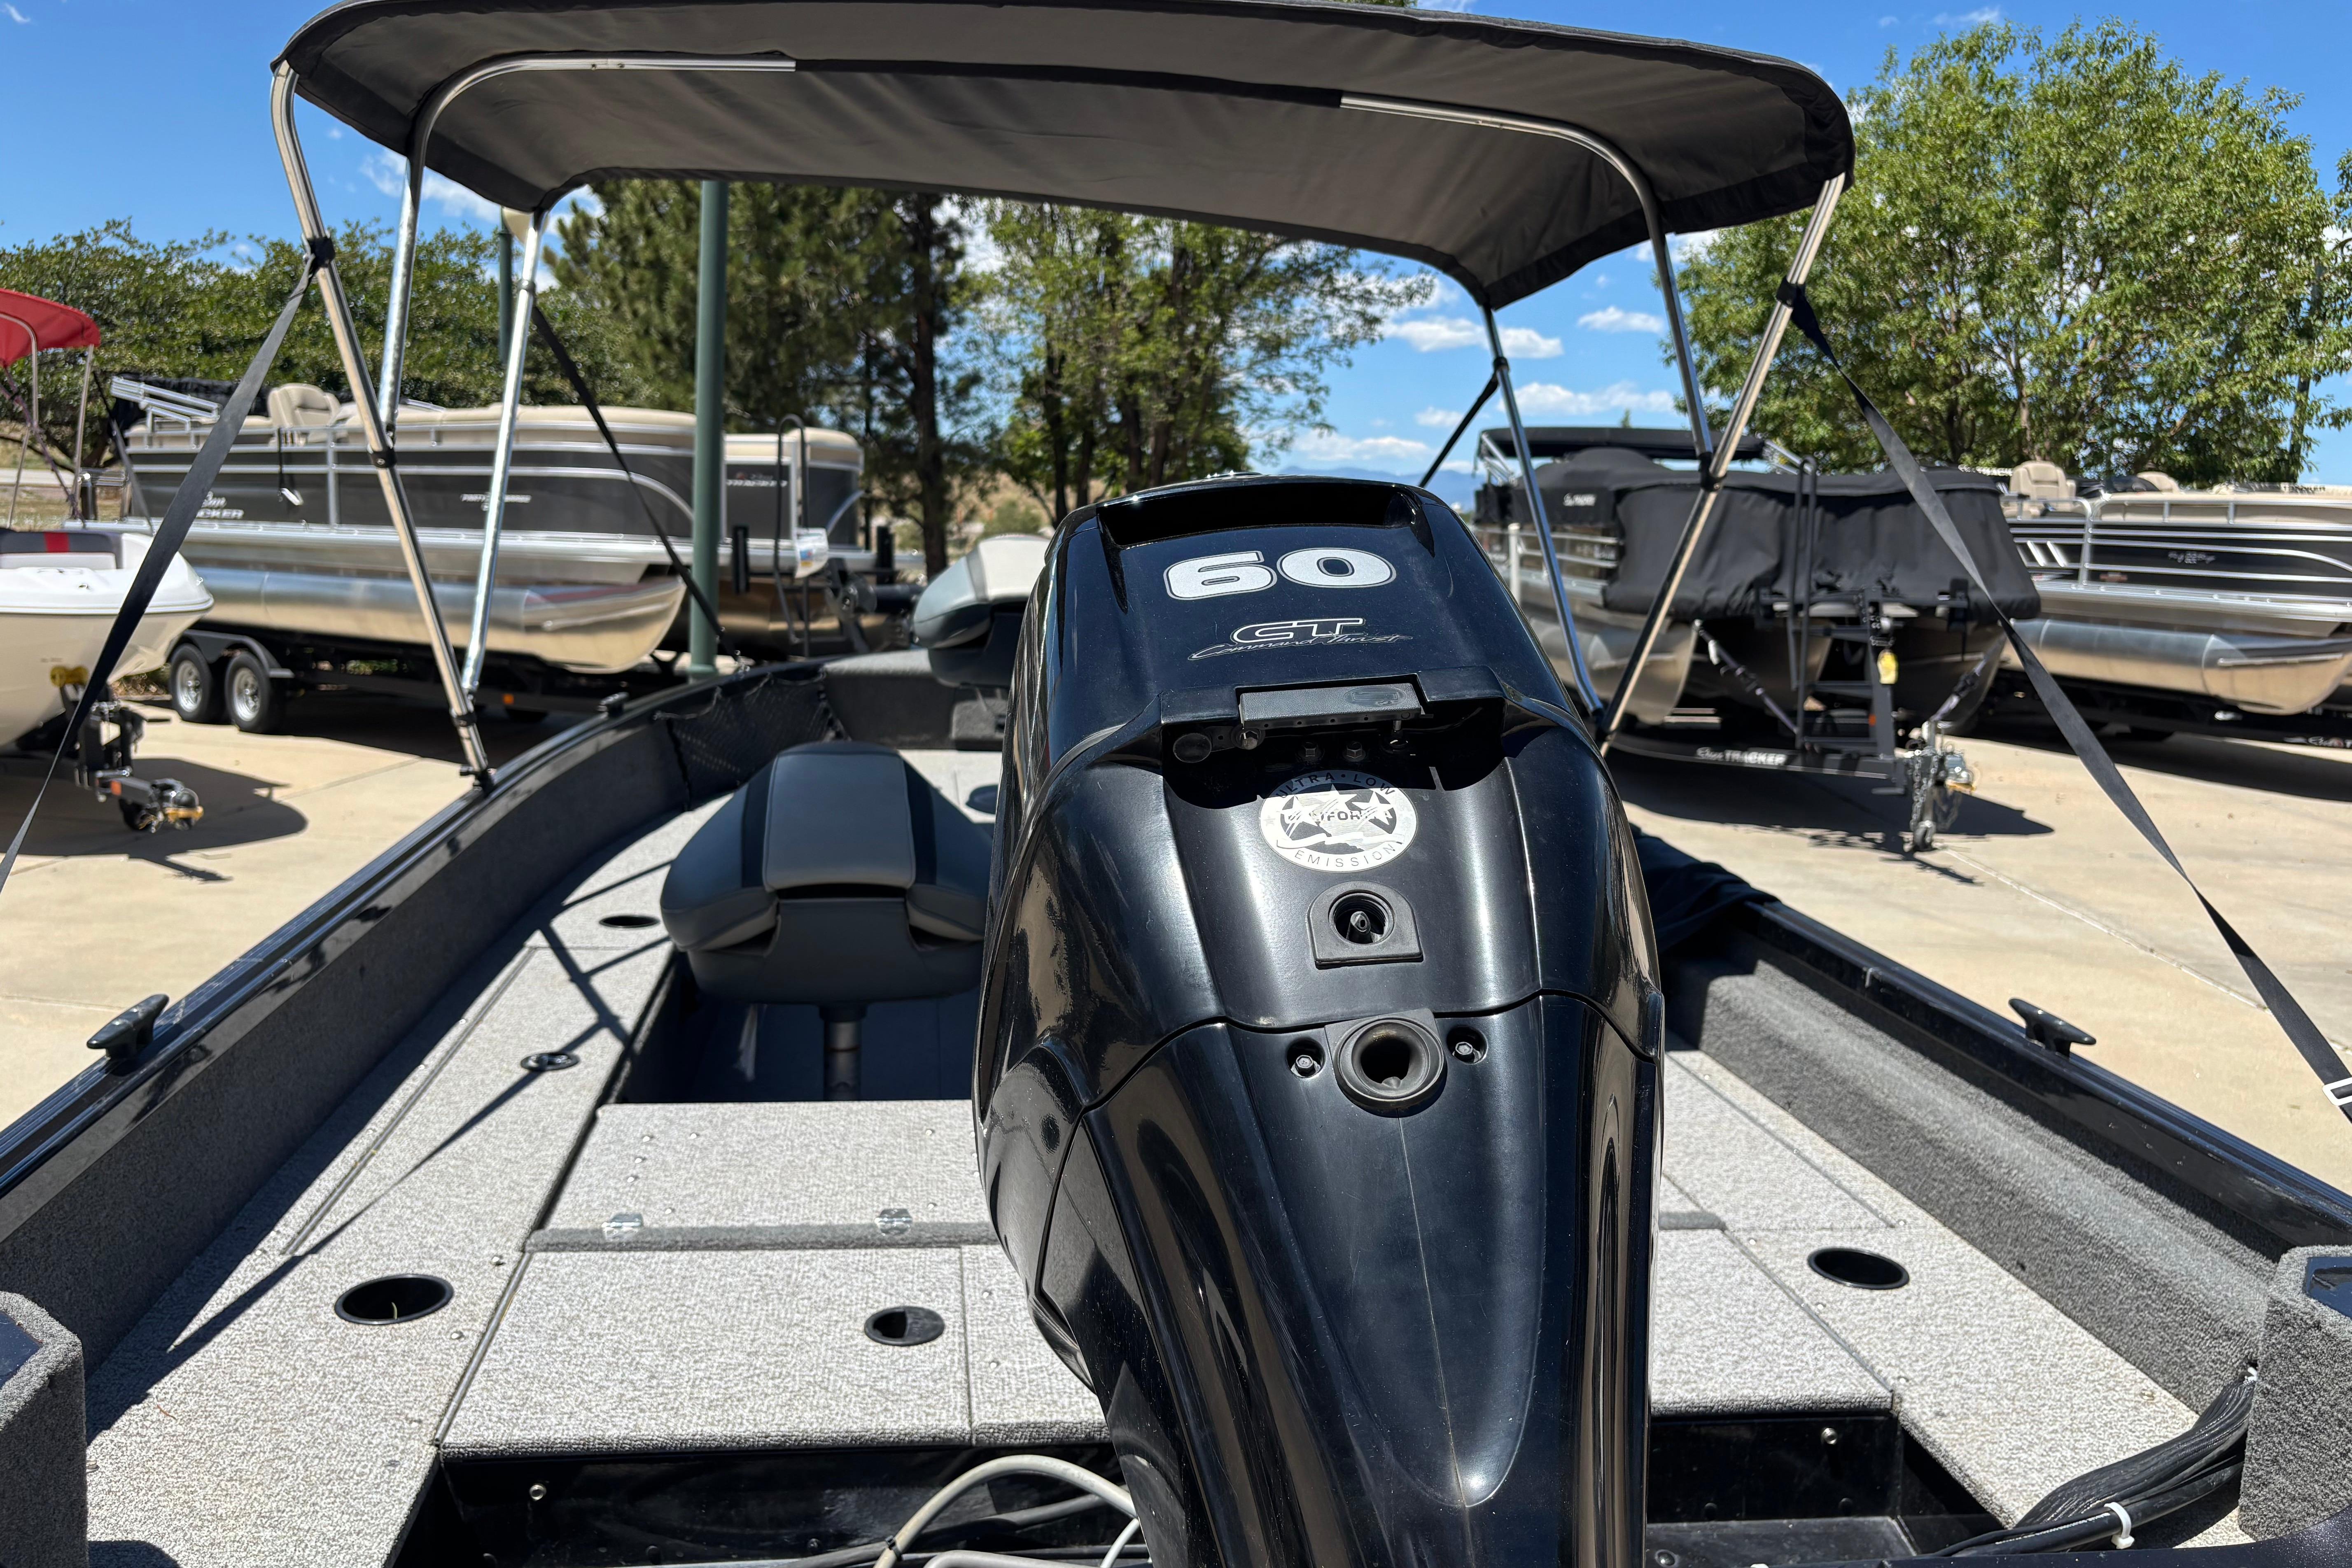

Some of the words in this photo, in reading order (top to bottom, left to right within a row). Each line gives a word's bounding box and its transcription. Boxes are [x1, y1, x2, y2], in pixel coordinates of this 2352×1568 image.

[1163, 547, 1397, 600] 60
[1232, 618, 1365, 644] GT
[1190, 637, 1321, 660] Command
[1325, 631, 1412, 645] Thrust
[1276, 772, 1335, 798] ULTRA
[1353, 774, 1395, 795] LOW
[1294, 843, 1396, 868] EMISSION
